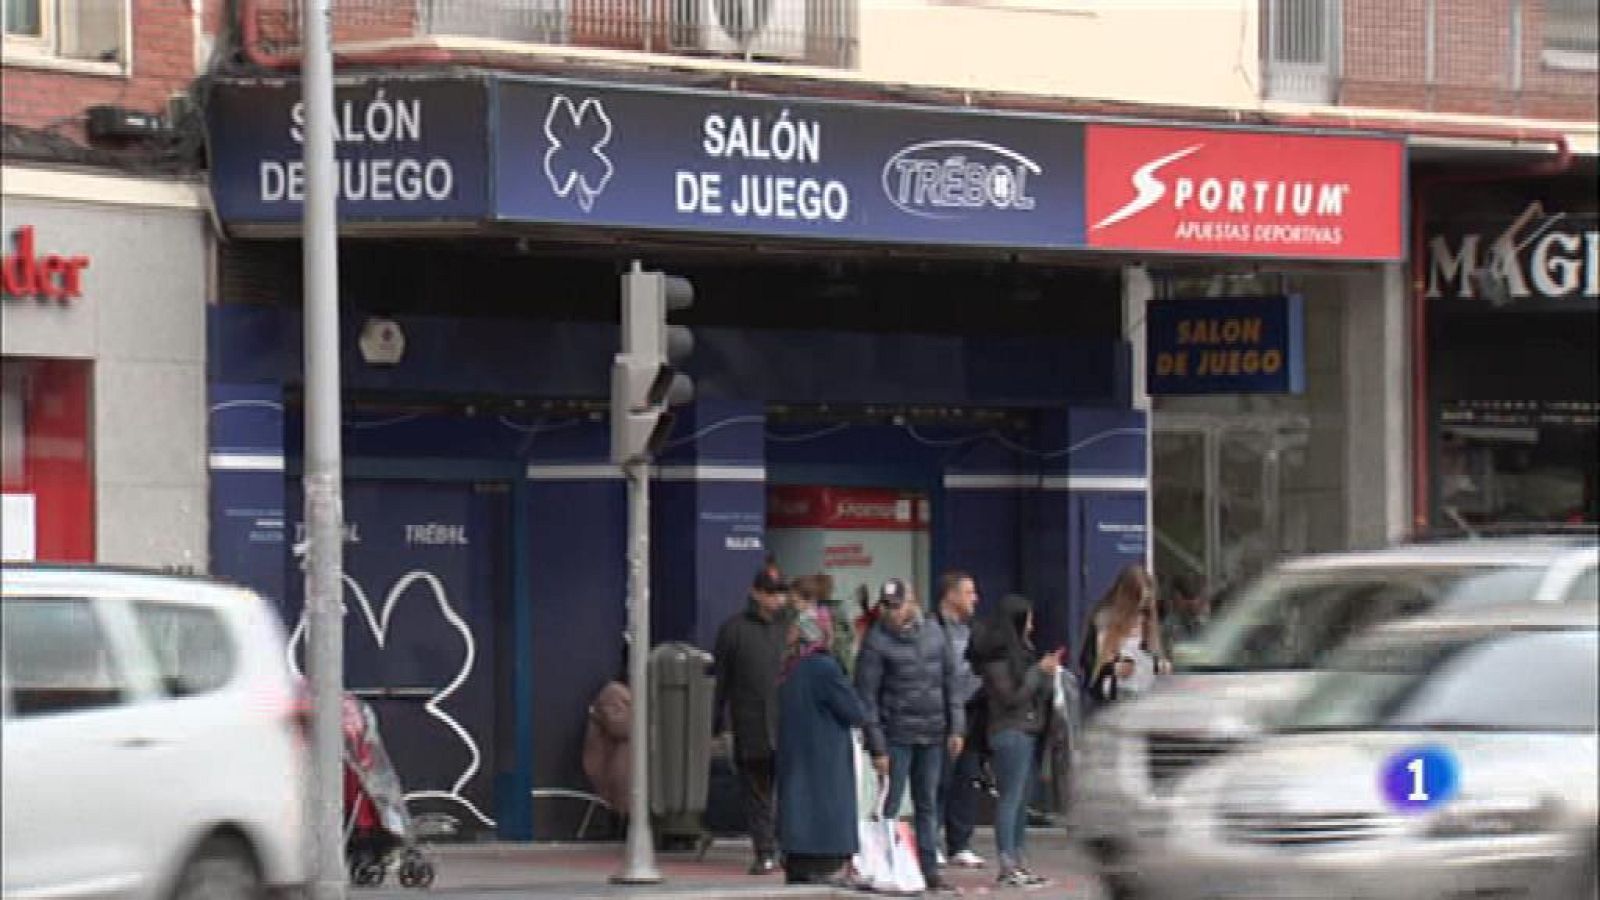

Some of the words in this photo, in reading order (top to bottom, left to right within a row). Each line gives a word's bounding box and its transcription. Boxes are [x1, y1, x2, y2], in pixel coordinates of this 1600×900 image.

[702, 109, 820, 163] SALÓN
[675, 171, 722, 214] DE
[730, 174, 848, 221] JUEGO
[895, 156, 1036, 210] TRÉBOL
[1174, 221, 1249, 241] APUESTAS
[1254, 224, 1342, 244] DEPORTIVAS
[1156, 352, 1188, 376] DE
[1196, 349, 1282, 376] JUEGO
